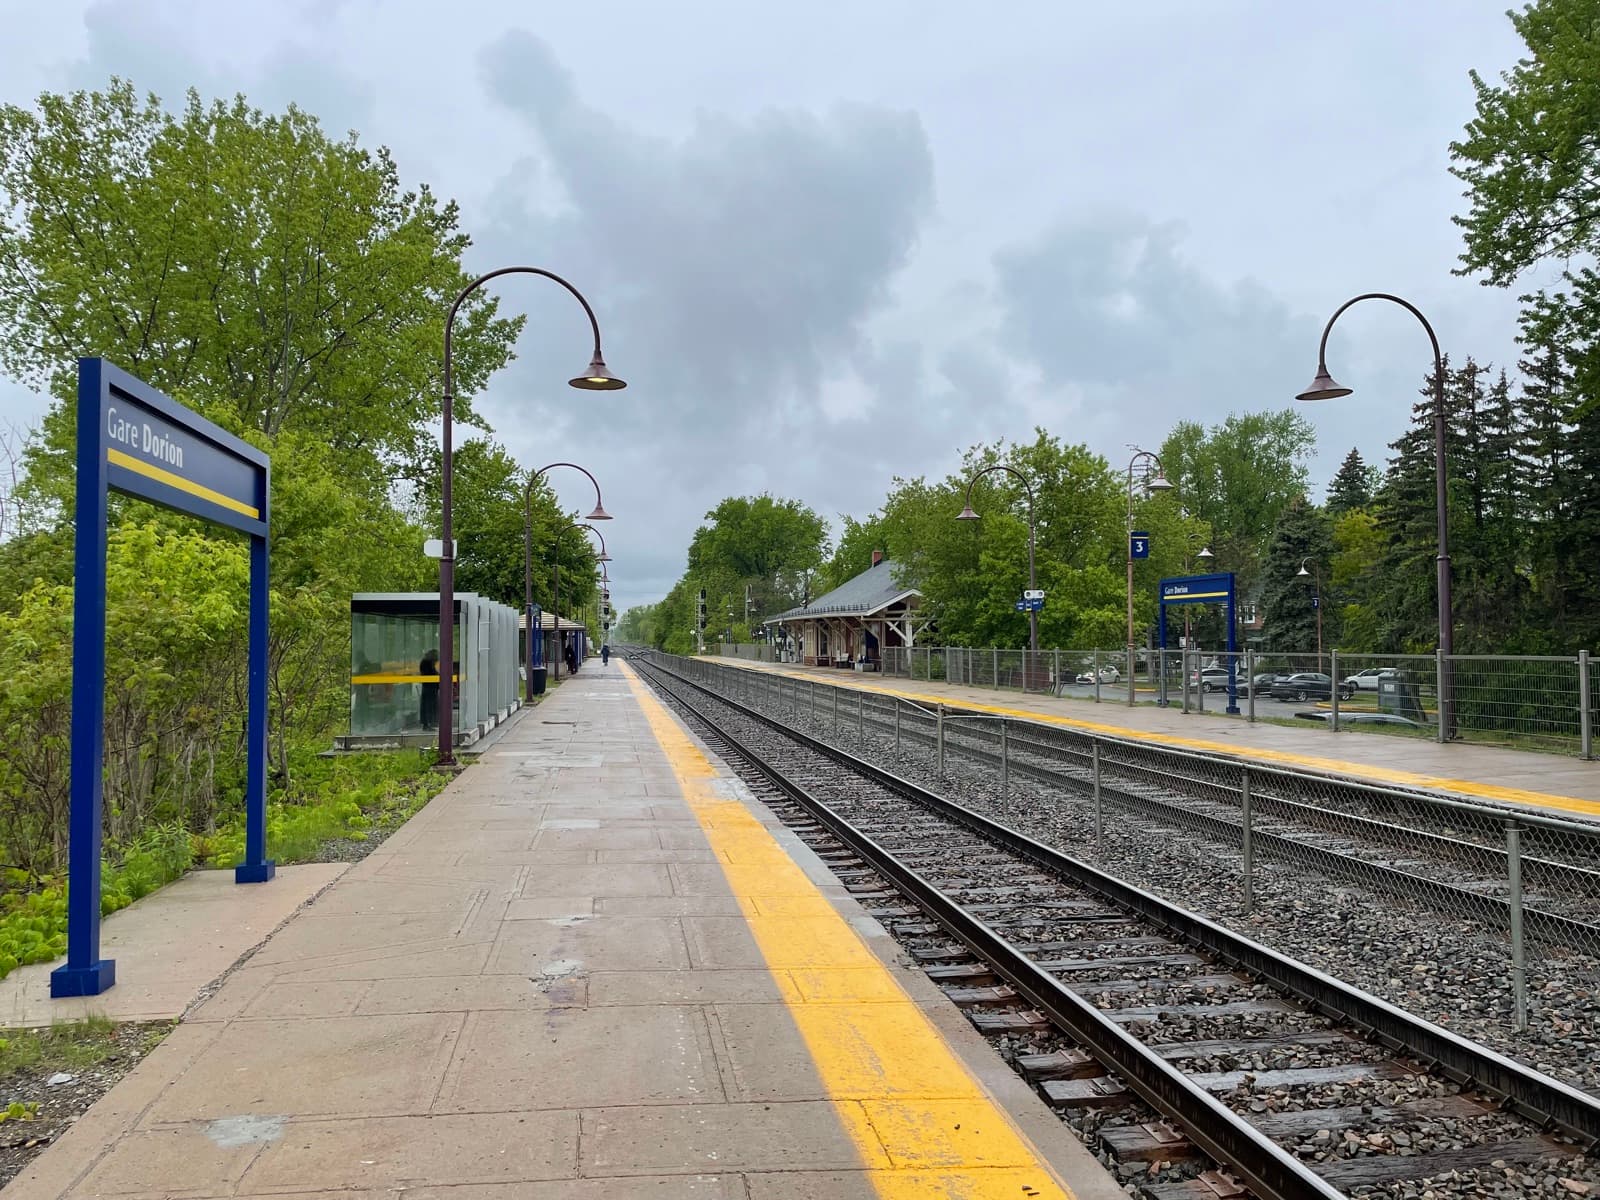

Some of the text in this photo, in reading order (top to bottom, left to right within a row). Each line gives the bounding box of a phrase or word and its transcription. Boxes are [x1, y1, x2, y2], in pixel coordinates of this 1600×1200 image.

[107, 407, 183, 468] Gare Dorion
[1135, 541, 1144, 553] 3
